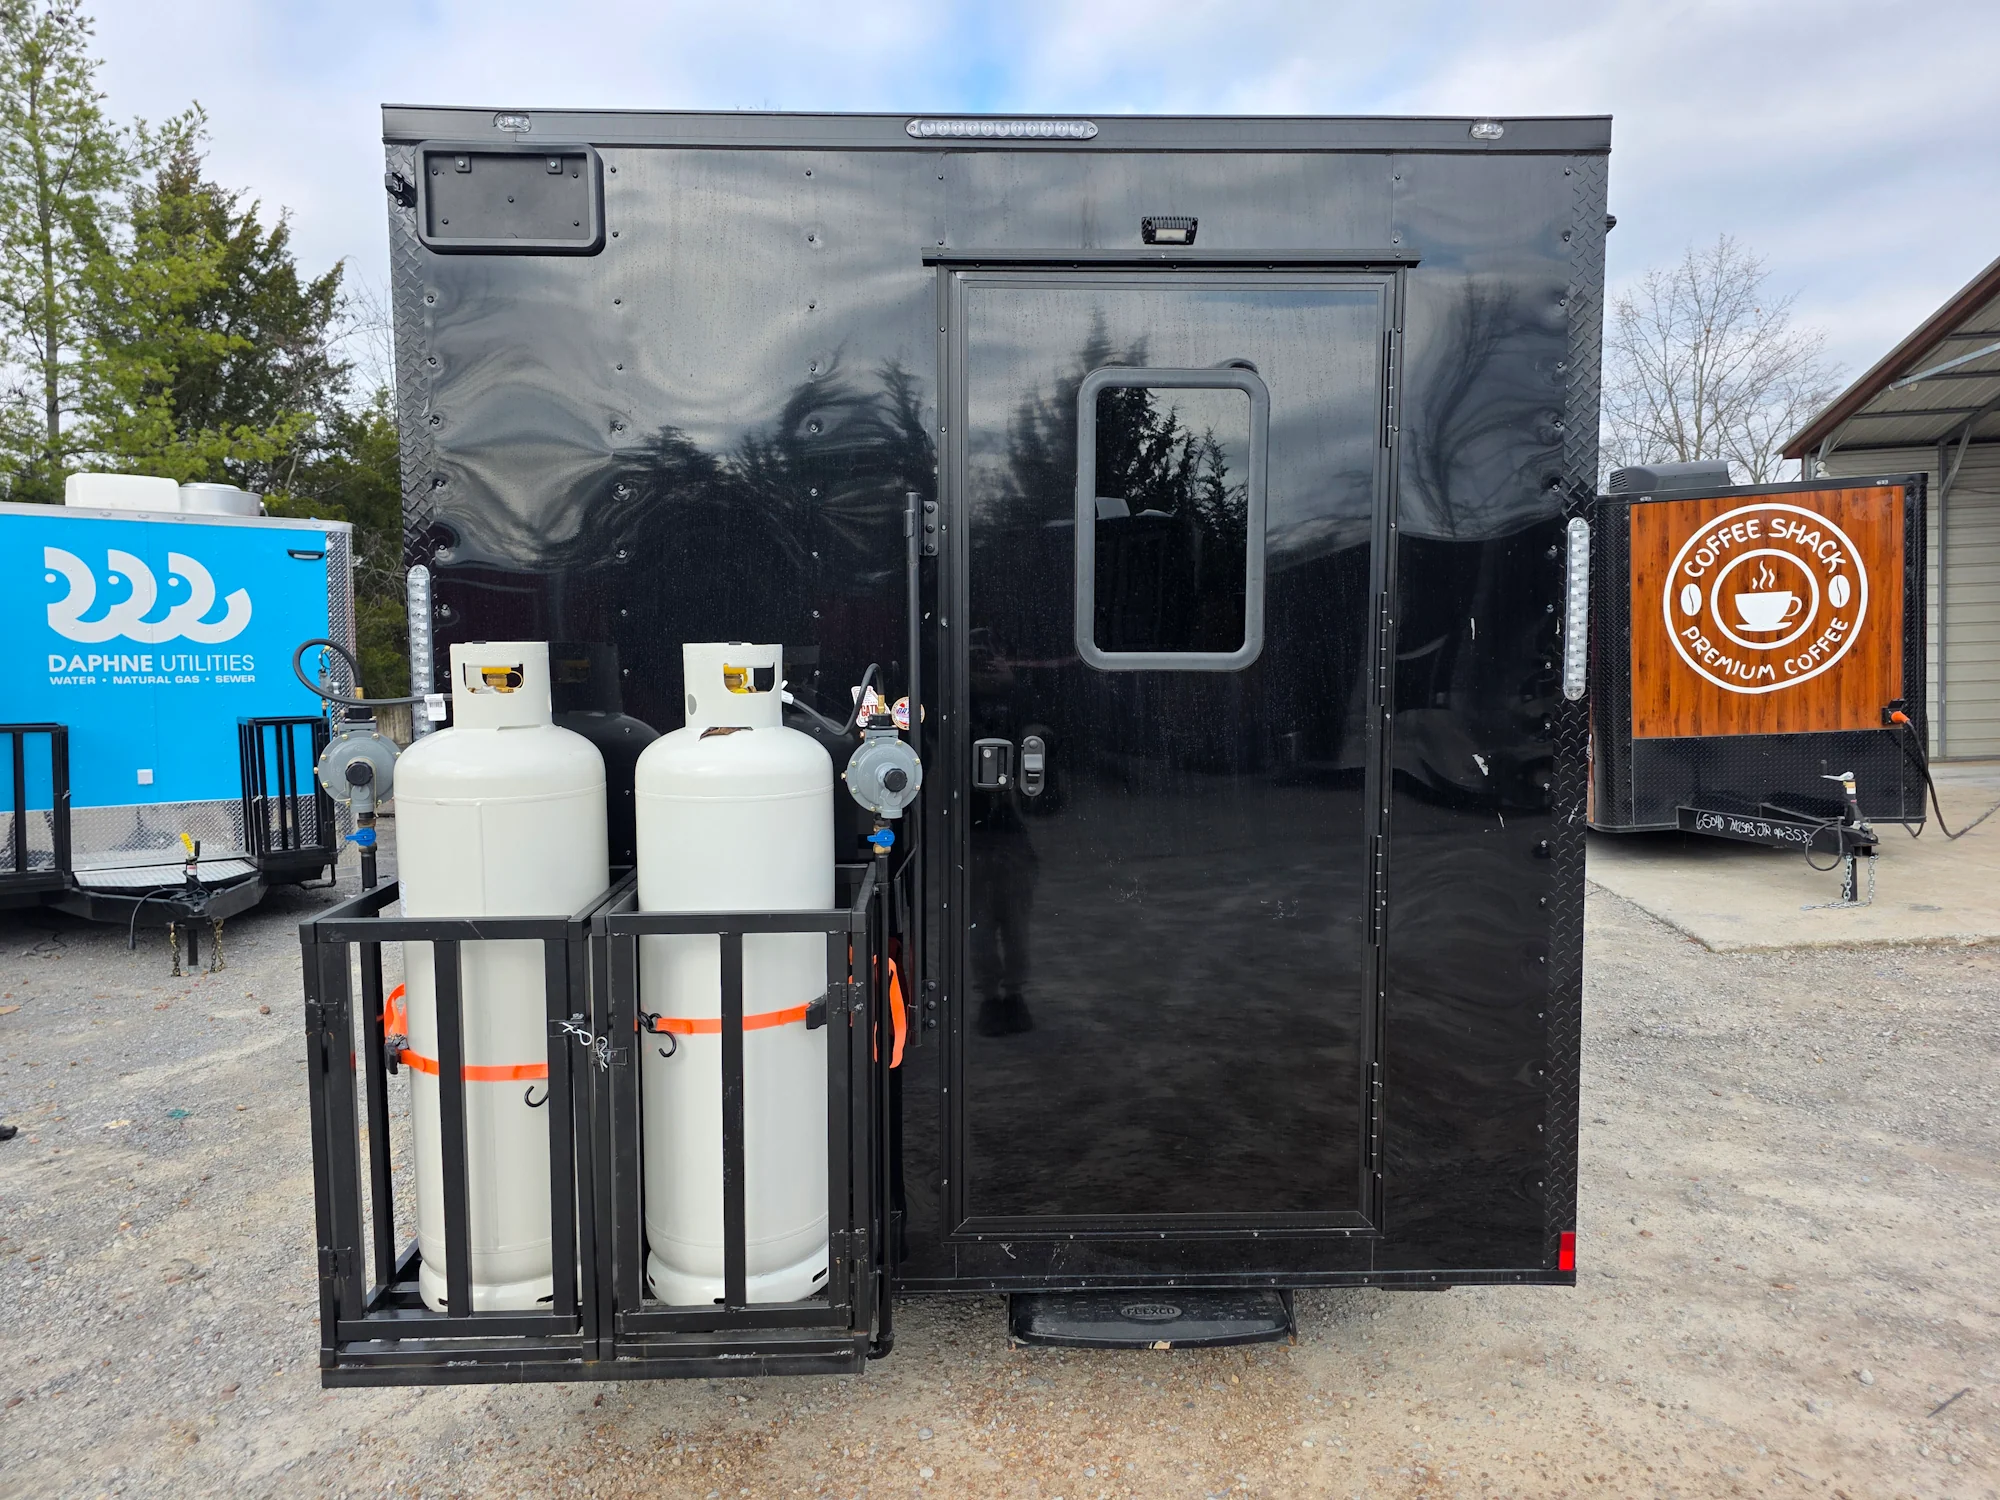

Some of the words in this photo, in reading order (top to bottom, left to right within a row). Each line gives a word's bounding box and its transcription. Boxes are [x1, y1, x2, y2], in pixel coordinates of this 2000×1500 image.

[1684, 519, 1761, 577] COFFEE
[1769, 518, 1846, 573] SHACK
[48, 655, 153, 672] DAPHNE
[161, 654, 255, 671] UTILITIES
[1681, 626, 1776, 680] PREMIUM
[1784, 617, 1848, 674] COFFEE
[49, 676, 96, 684] WATER
[113, 675, 171, 684] NATURAL
[175, 675, 200, 683] GAS
[215, 674, 256, 683] SEWER
